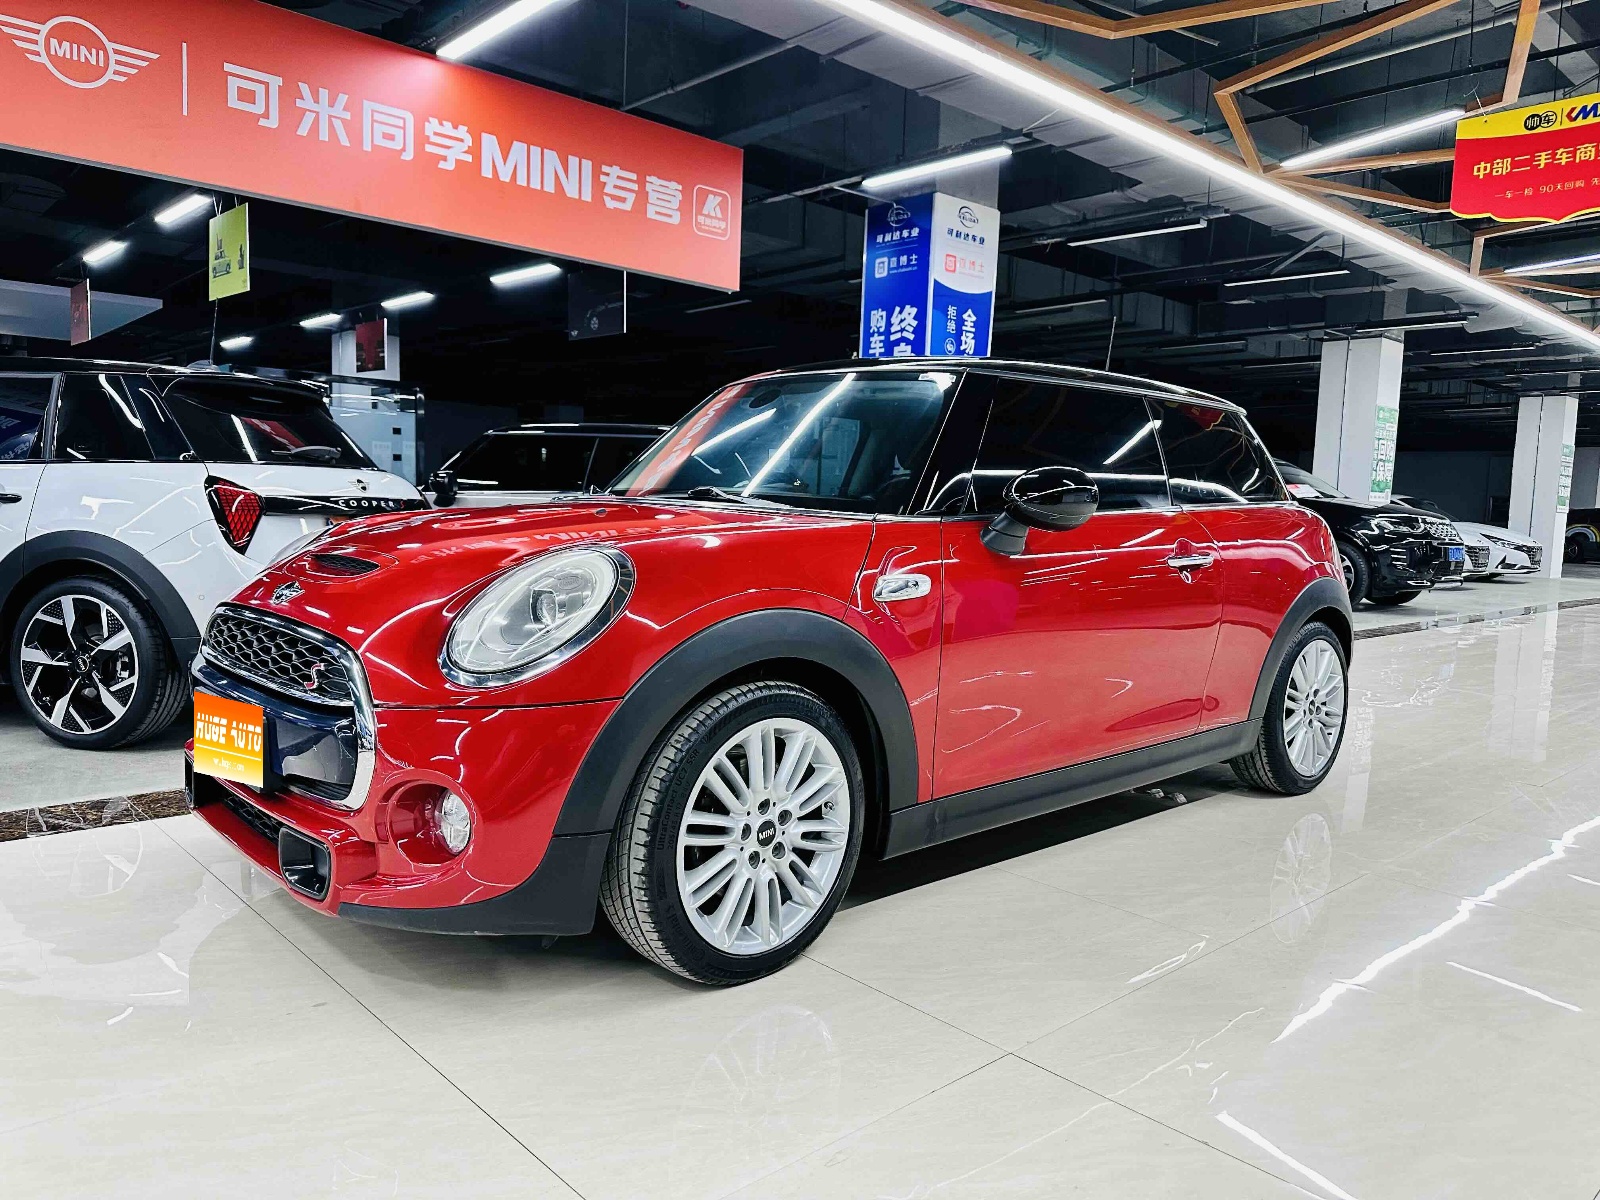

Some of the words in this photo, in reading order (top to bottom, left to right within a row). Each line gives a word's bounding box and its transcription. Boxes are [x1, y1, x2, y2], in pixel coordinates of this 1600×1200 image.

[49, 37, 105, 67] MINI
[223, 62, 682, 225] 可米同学MINI专营
[1473, 142, 1600, 179] 中部二手车商
[946, 305, 958, 334] 拒绝
[959, 308, 977, 356] 全场
[338, 499, 395, 508] COOPER
[400, 500, 406, 509] S
[657, 789, 678, 851] UltraContact
[758, 827, 775, 841] MINI
